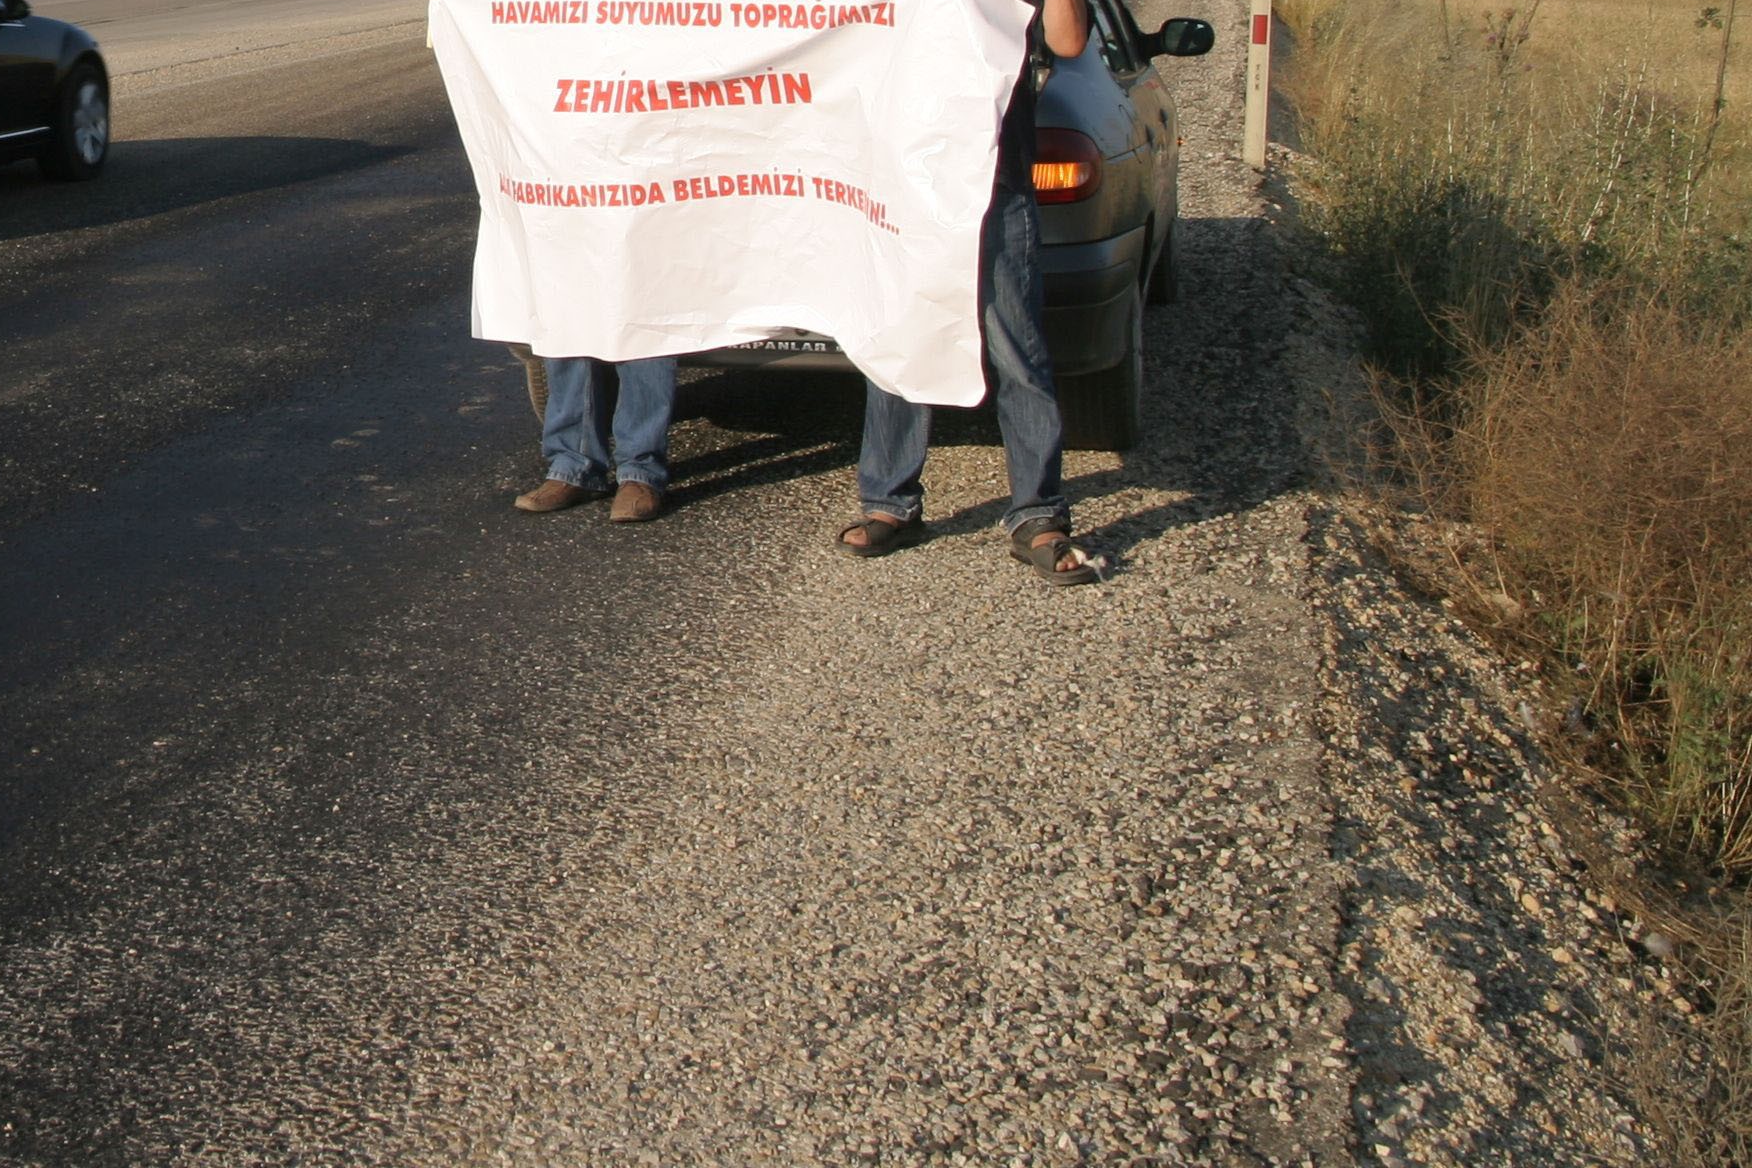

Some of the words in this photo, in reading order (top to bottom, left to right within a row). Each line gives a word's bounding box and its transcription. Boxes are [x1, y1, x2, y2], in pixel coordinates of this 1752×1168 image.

[491, 0, 589, 24] HAVAMIZI
[596, 0, 723, 27] SUYUMUZU
[553, 66, 813, 113] ZEHİRLEMEYİN
[673, 166, 805, 201] BELDEMİZİ
